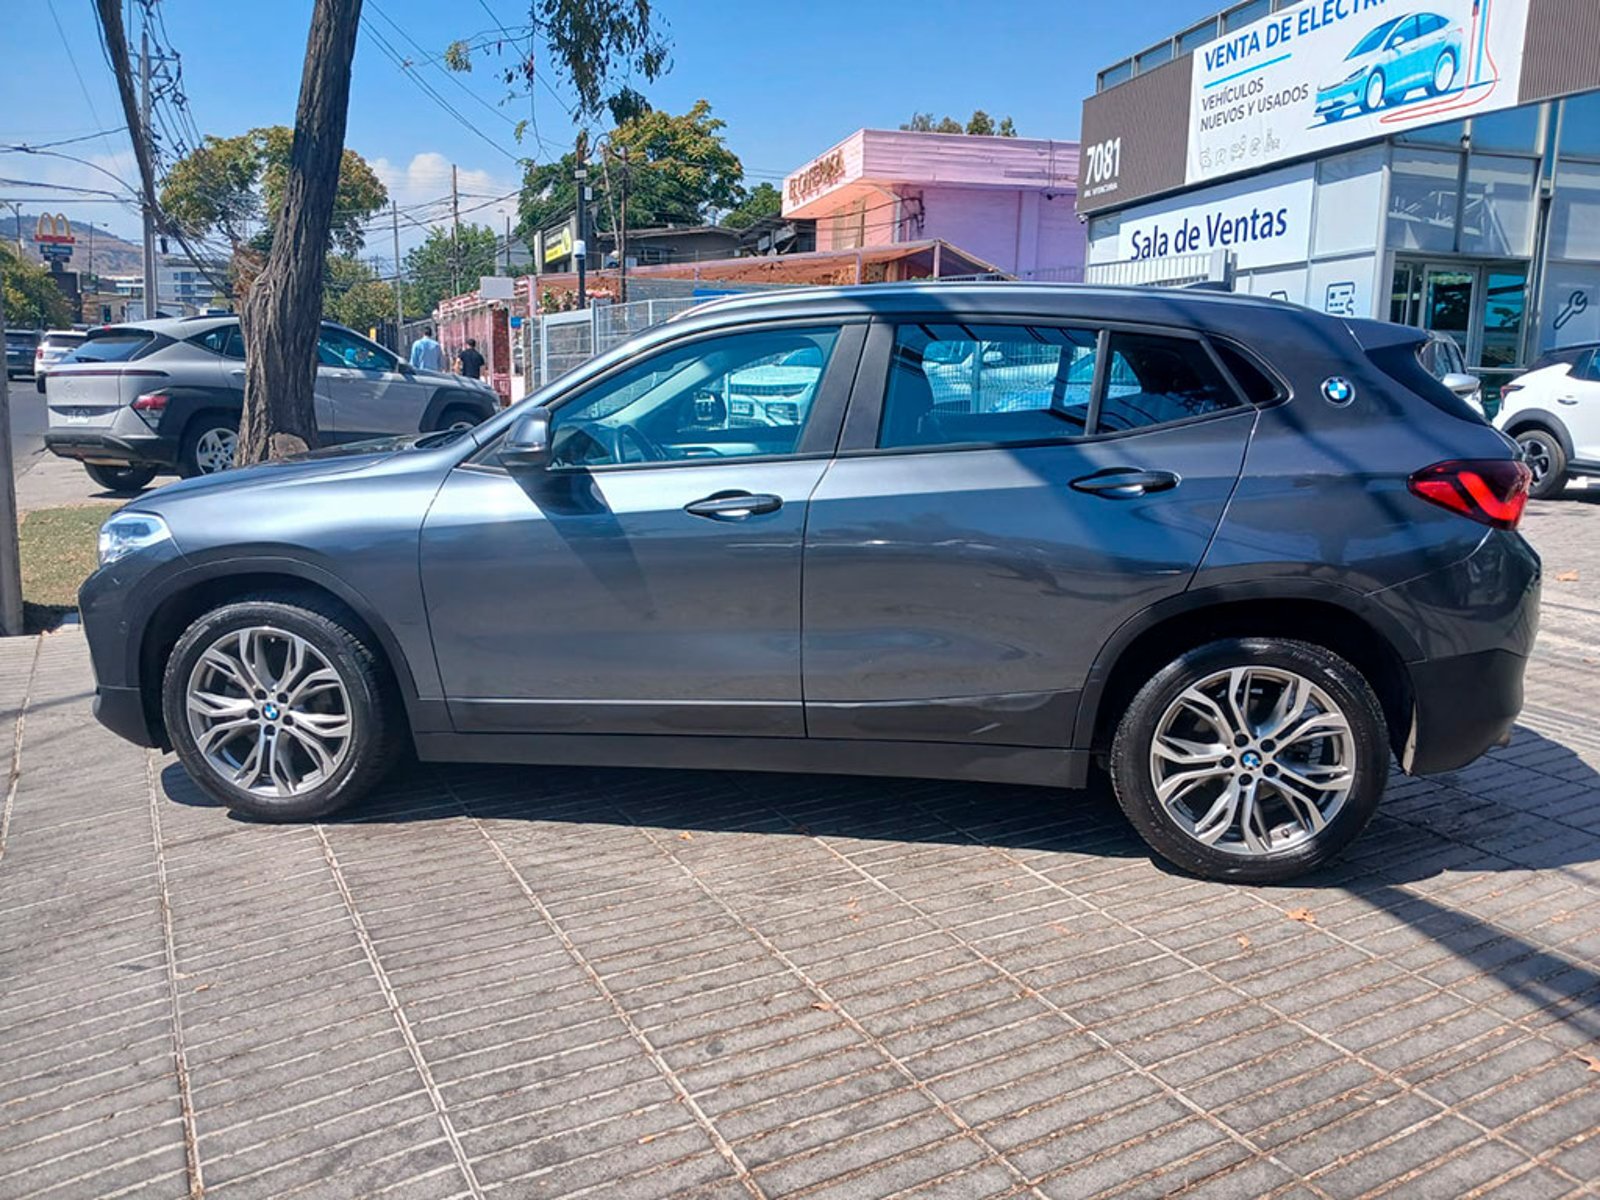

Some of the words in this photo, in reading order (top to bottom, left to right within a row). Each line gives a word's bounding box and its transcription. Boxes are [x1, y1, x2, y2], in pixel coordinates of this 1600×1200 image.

[1204, 32, 1260, 72] VENTA
[1265, 17, 1292, 48] DE
[1297, 0, 1385, 35] ELEC
[1200, 104, 1245, 132] NUEVOS
[1246, 101, 1257, 116] Y
[1257, 83, 1309, 113] USADOS
[1201, 77, 1264, 111] VEHÍCULOS
[1085, 137, 1121, 185] 7081
[1130, 225, 1168, 260] Sala
[1174, 218, 1201, 253] de
[1206, 208, 1288, 247] Ventas
